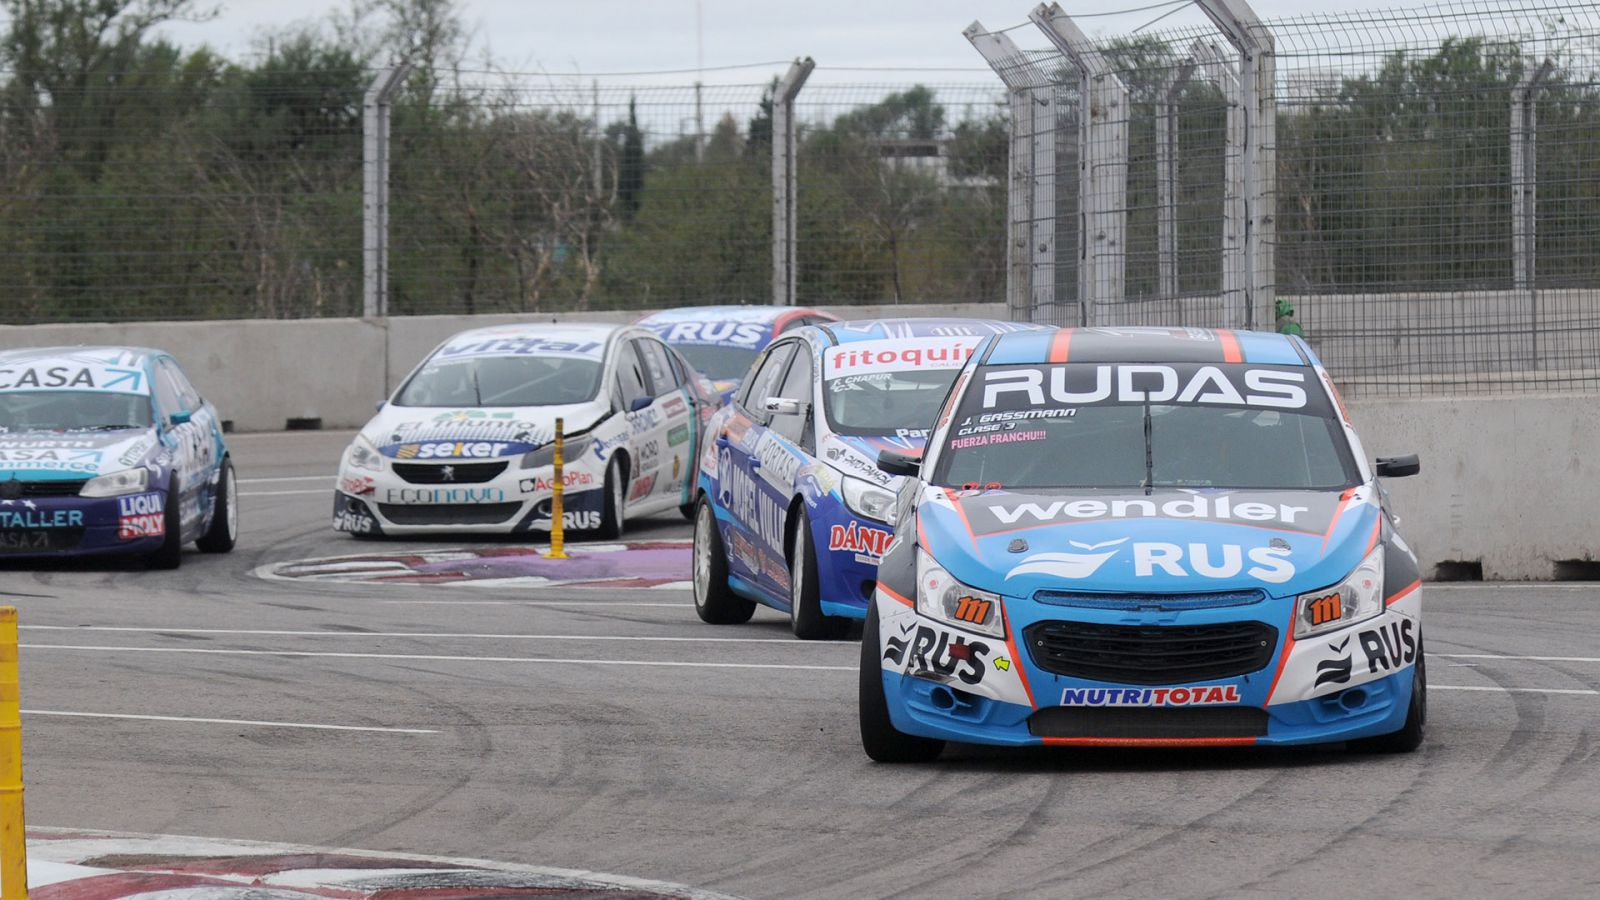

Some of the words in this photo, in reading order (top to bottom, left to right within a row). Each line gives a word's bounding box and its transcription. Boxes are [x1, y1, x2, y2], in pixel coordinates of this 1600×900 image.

[668, 322, 766, 343] RUS
[0, 367, 95, 388] CASA
[845, 373, 892, 384] CHAPUR
[982, 365, 1307, 408] RUDAS
[958, 425, 999, 436] CLASE
[1004, 422, 1017, 430] 3
[961, 417, 972, 426] J.
[418, 442, 509, 458] seker
[951, 435, 988, 449] FUERZA
[990, 431, 1047, 444] FRANCHU!!!
[120, 495, 162, 516] LIQUI
[988, 495, 1308, 524] wendler
[0, 510, 83, 528] TALLER
[122, 514, 165, 537] MOLY
[344, 514, 373, 532] RUS
[562, 511, 602, 529] RUS
[1132, 541, 1297, 584] RUS
[908, 625, 991, 685] RUS
[1358, 618, 1416, 674] RUS
[1061, 686, 1240, 706] NUTRITOTAL
